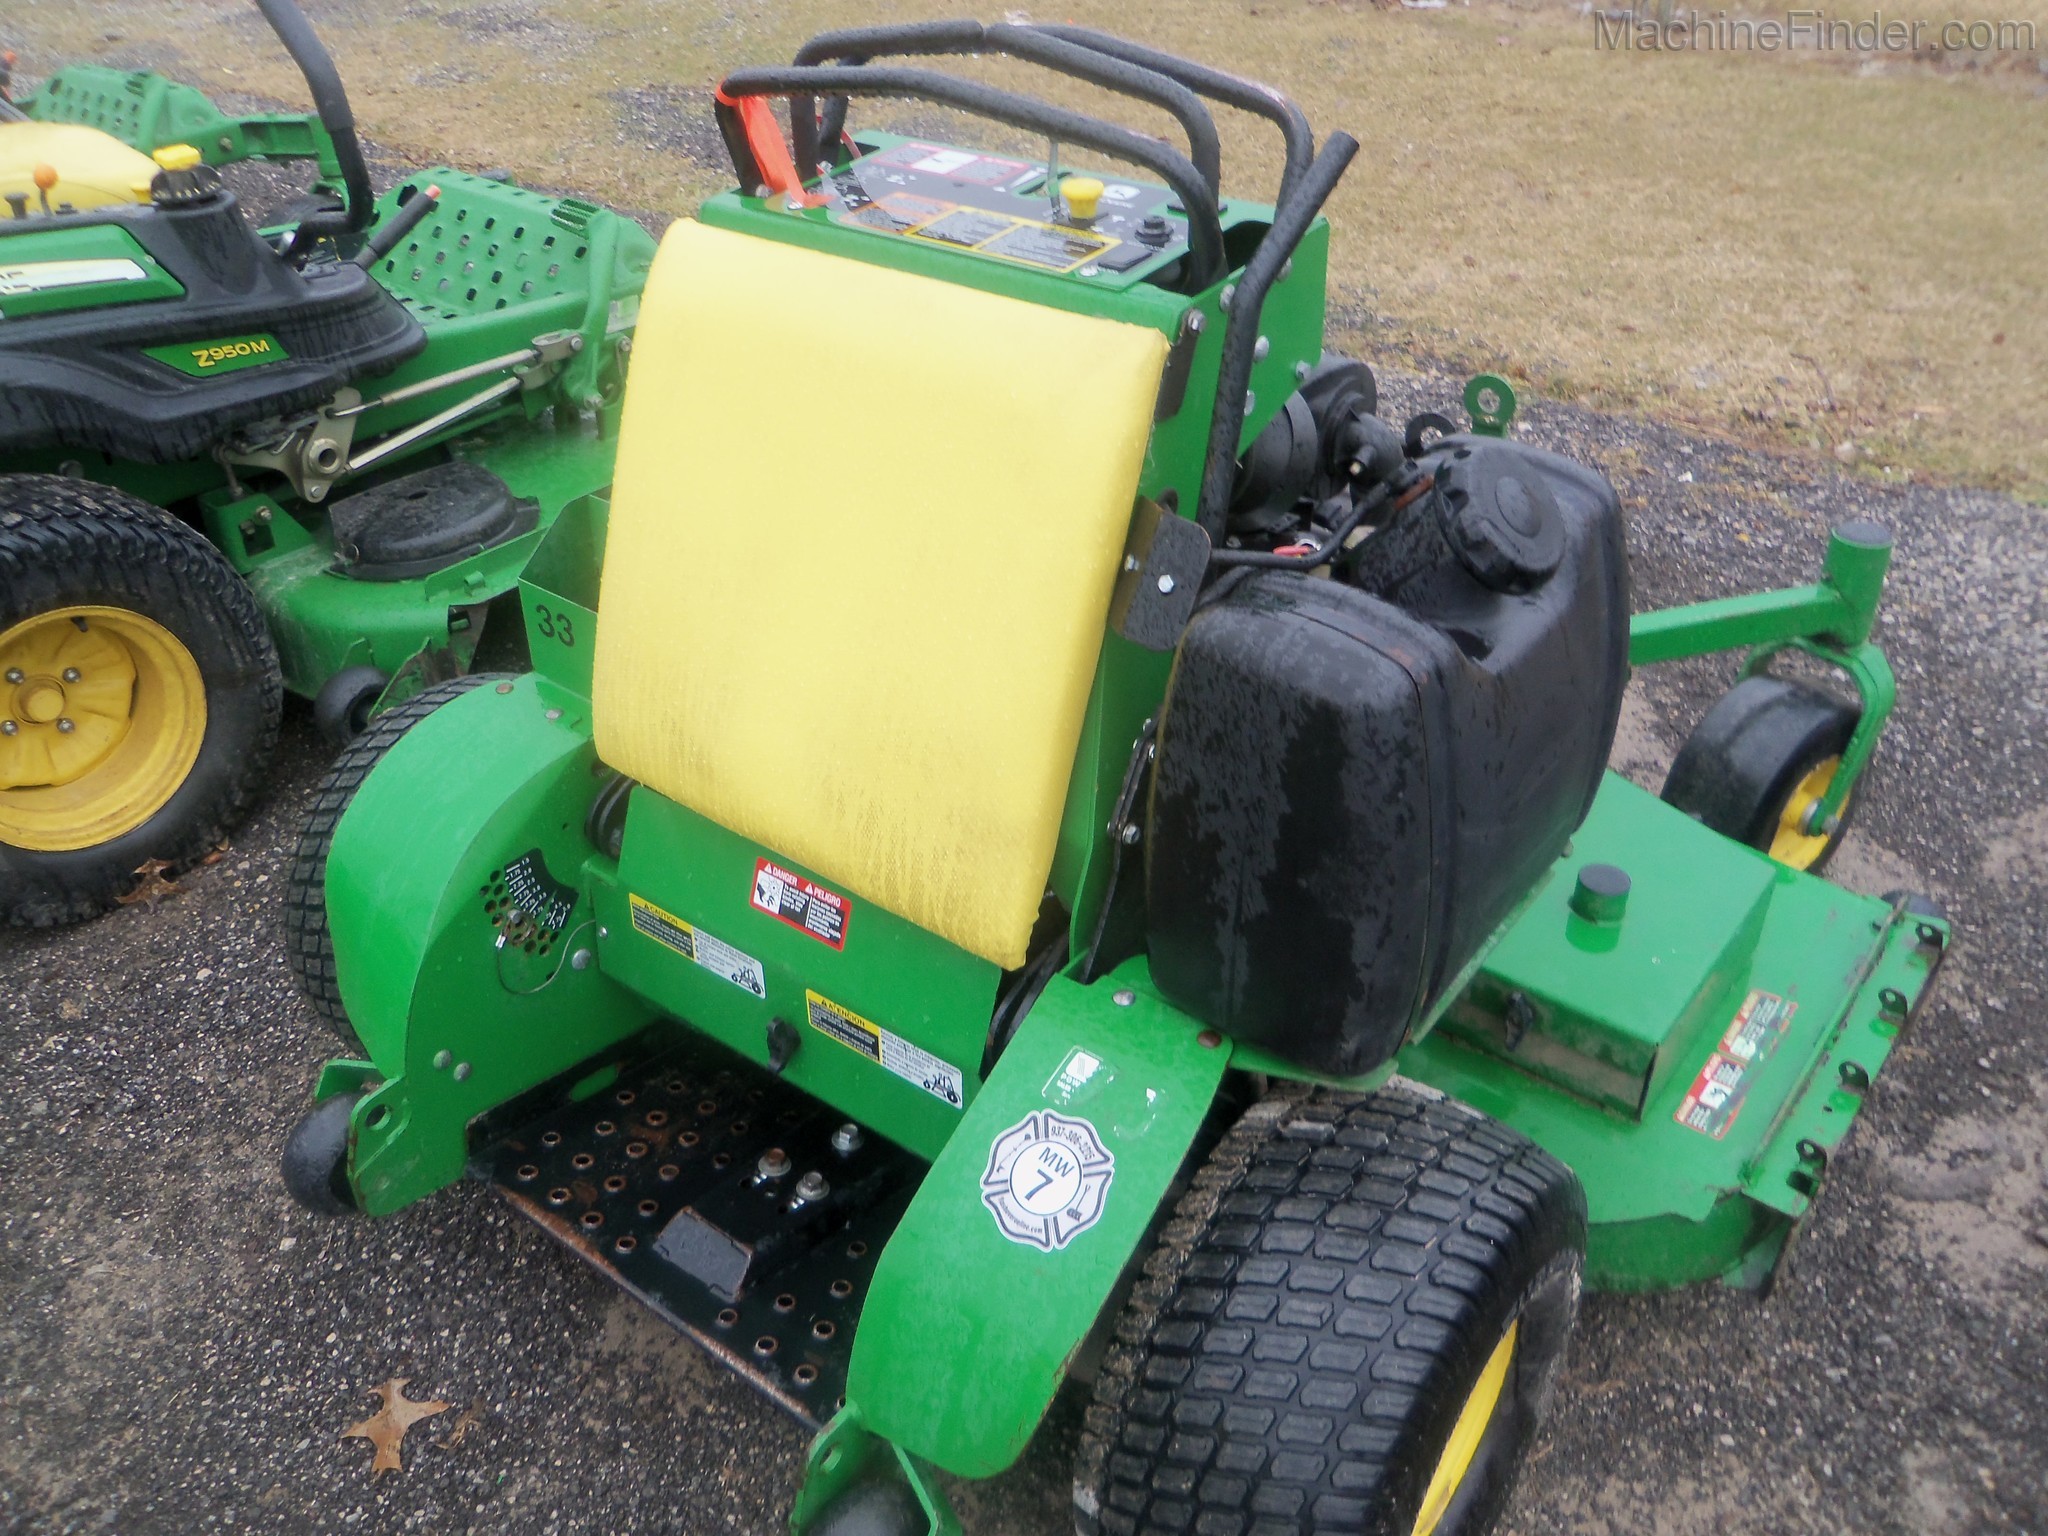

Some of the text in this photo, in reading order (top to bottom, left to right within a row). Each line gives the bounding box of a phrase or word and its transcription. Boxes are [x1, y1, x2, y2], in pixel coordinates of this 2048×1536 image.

[191, 339, 271, 368] Z950M
[535, 604, 576, 647] 33
[772, 866, 798, 887] DANGER
[813, 886, 841, 908] PELIGRO
[649, 905, 678, 926] CAUTION
[1038, 1146, 1075, 1178] MW
[1024, 1168, 1054, 1202] 7
